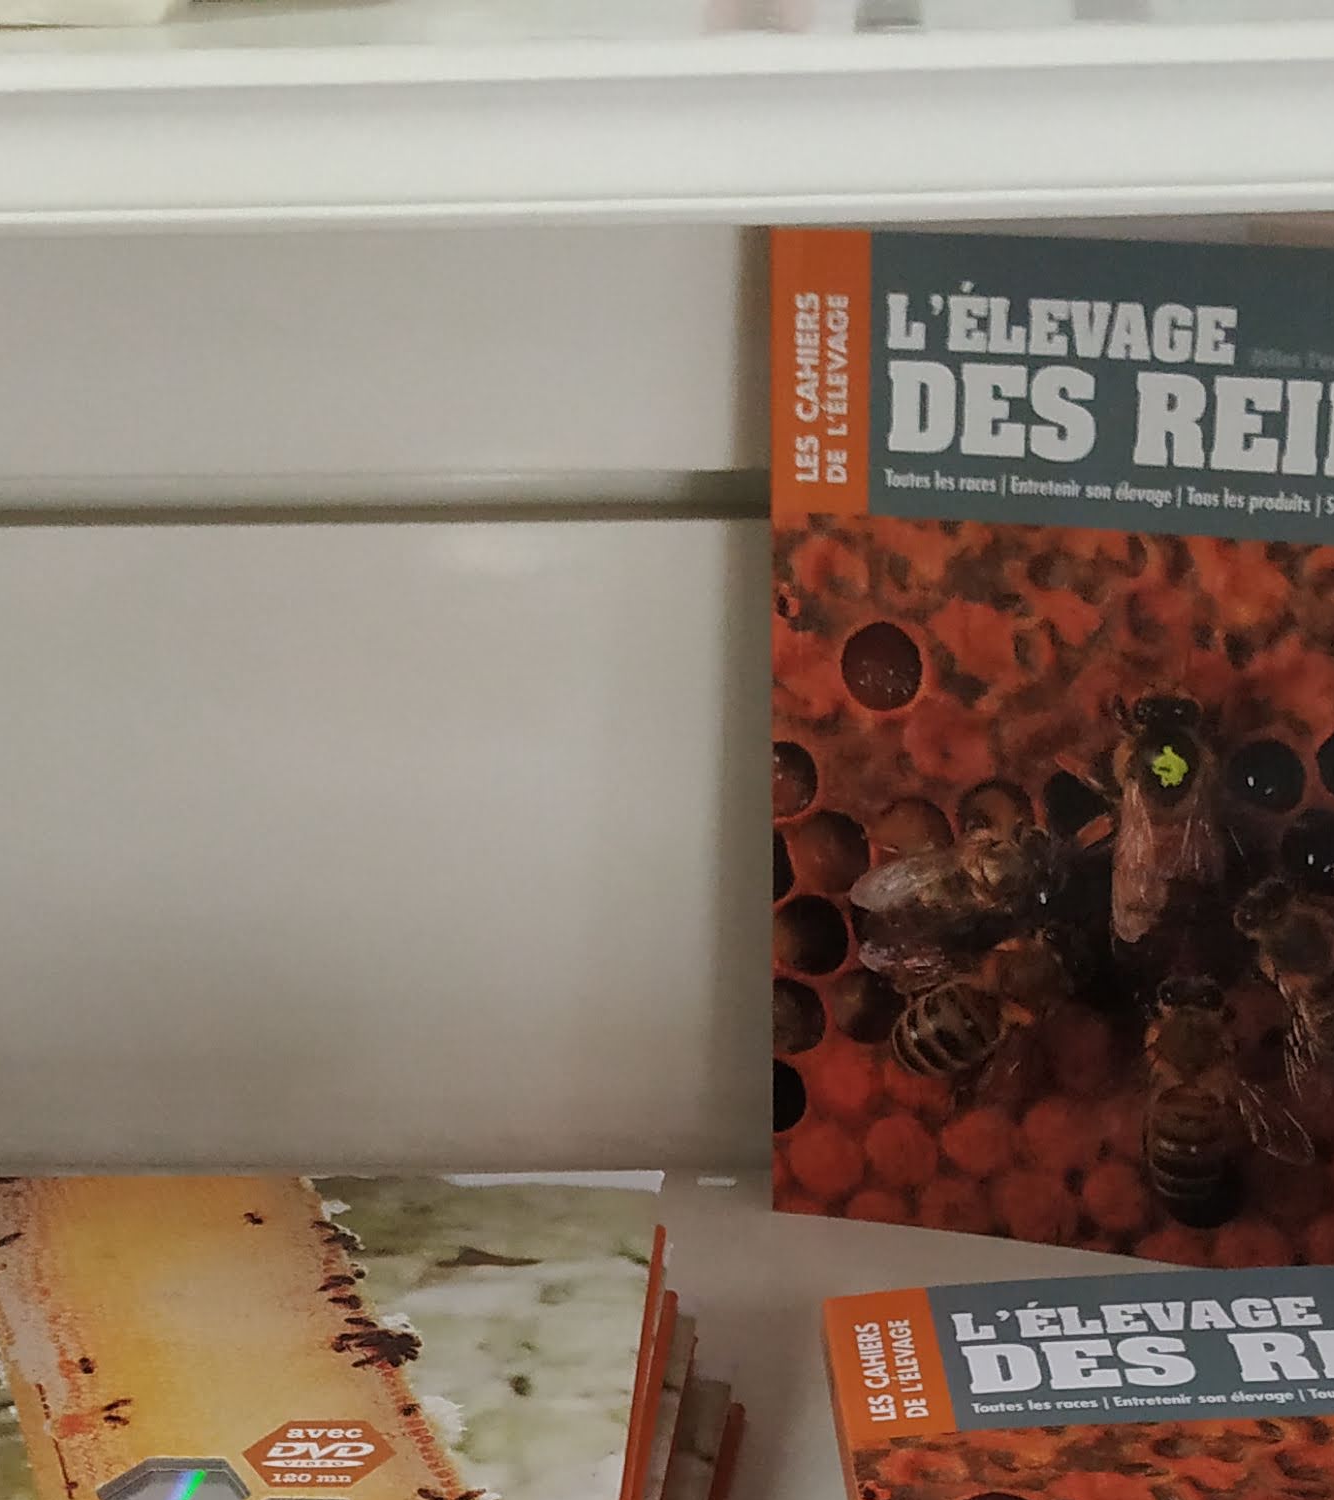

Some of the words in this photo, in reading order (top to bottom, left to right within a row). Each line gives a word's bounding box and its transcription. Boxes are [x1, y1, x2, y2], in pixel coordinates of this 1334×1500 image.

[885, 281, 1238, 365] L'ÉLEVAGE
[795, 292, 820, 422] CAHIERS
[825, 294, 850, 436] L'ÉLEVAGE
[887, 360, 1096, 462] DES
[796, 435, 820, 483] LES
[826, 449, 848, 483] DE
[885, 468, 931, 491] Toutes
[934, 469, 956, 492] les
[959, 475, 996, 494] races
[1010, 476, 1080, 501] Entretenir
[1085, 484, 1111, 501] son
[1115, 484, 1172, 508] élevage
[1187, 486, 1220, 508] Tous
[1223, 487, 1245, 509] les
[1248, 491, 1312, 514] produits
[952, 1295, 1319, 1343] L'ÉLEVAGE
[854, 1322, 890, 1389] CAHIERS
[887, 1319, 923, 1393] L'ÉLEVAGE
[960, 1336, 1197, 1396] DES
[867, 1394, 897, 1422] LES
[903, 1398, 929, 1419] DE
[971, 1400, 1024, 1415] Toutes
[1028, 1399, 1052, 1413] les
[1056, 1398, 1099, 1411] races
[1112, 1394, 1192, 1409] Entretenir
[1198, 1393, 1227, 1405] son
[1230, 1389, 1295, 1405] élevage
[266, 1441, 376, 1461] DVD
[286, 1427, 364, 1440] avec
[316, 1473, 353, 1484] mn
